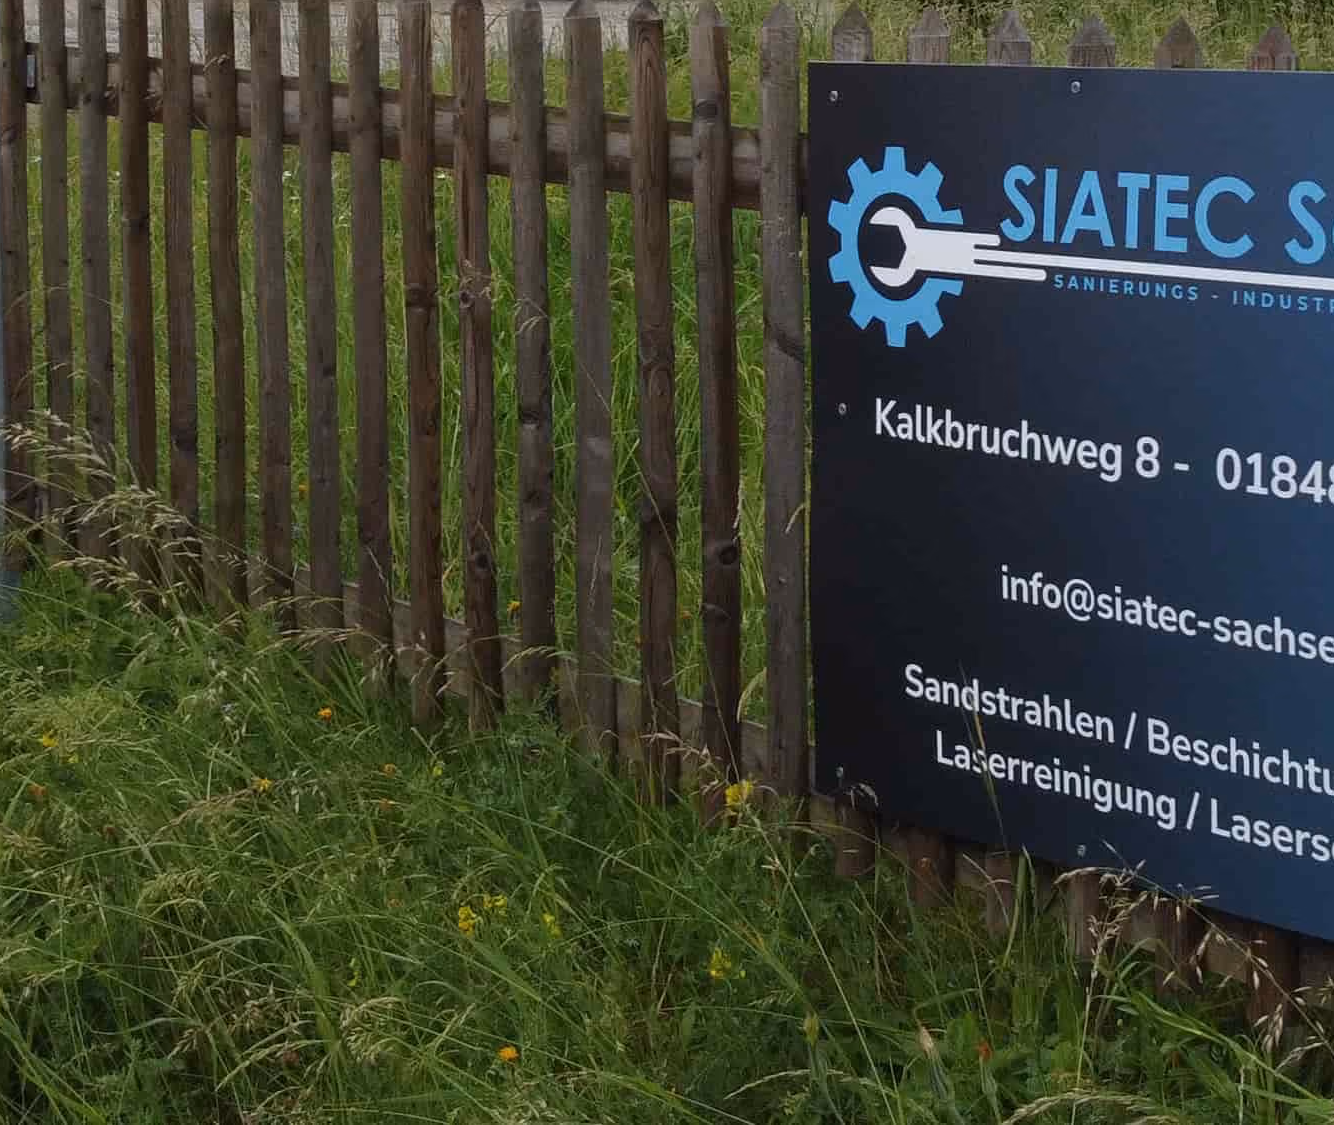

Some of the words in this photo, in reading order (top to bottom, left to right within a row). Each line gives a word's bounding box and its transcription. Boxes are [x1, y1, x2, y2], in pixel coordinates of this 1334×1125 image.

[1000, 165, 1257, 259] SIATEC
[1054, 275, 1200, 301] SANIERUNGS
[875, 398, 1123, 483] Kalkbruchweg
[1135, 437, 1161, 479] 8
[904, 663, 1116, 744] Sandstrahlen
[935, 729, 1177, 831] Laserreinigung
